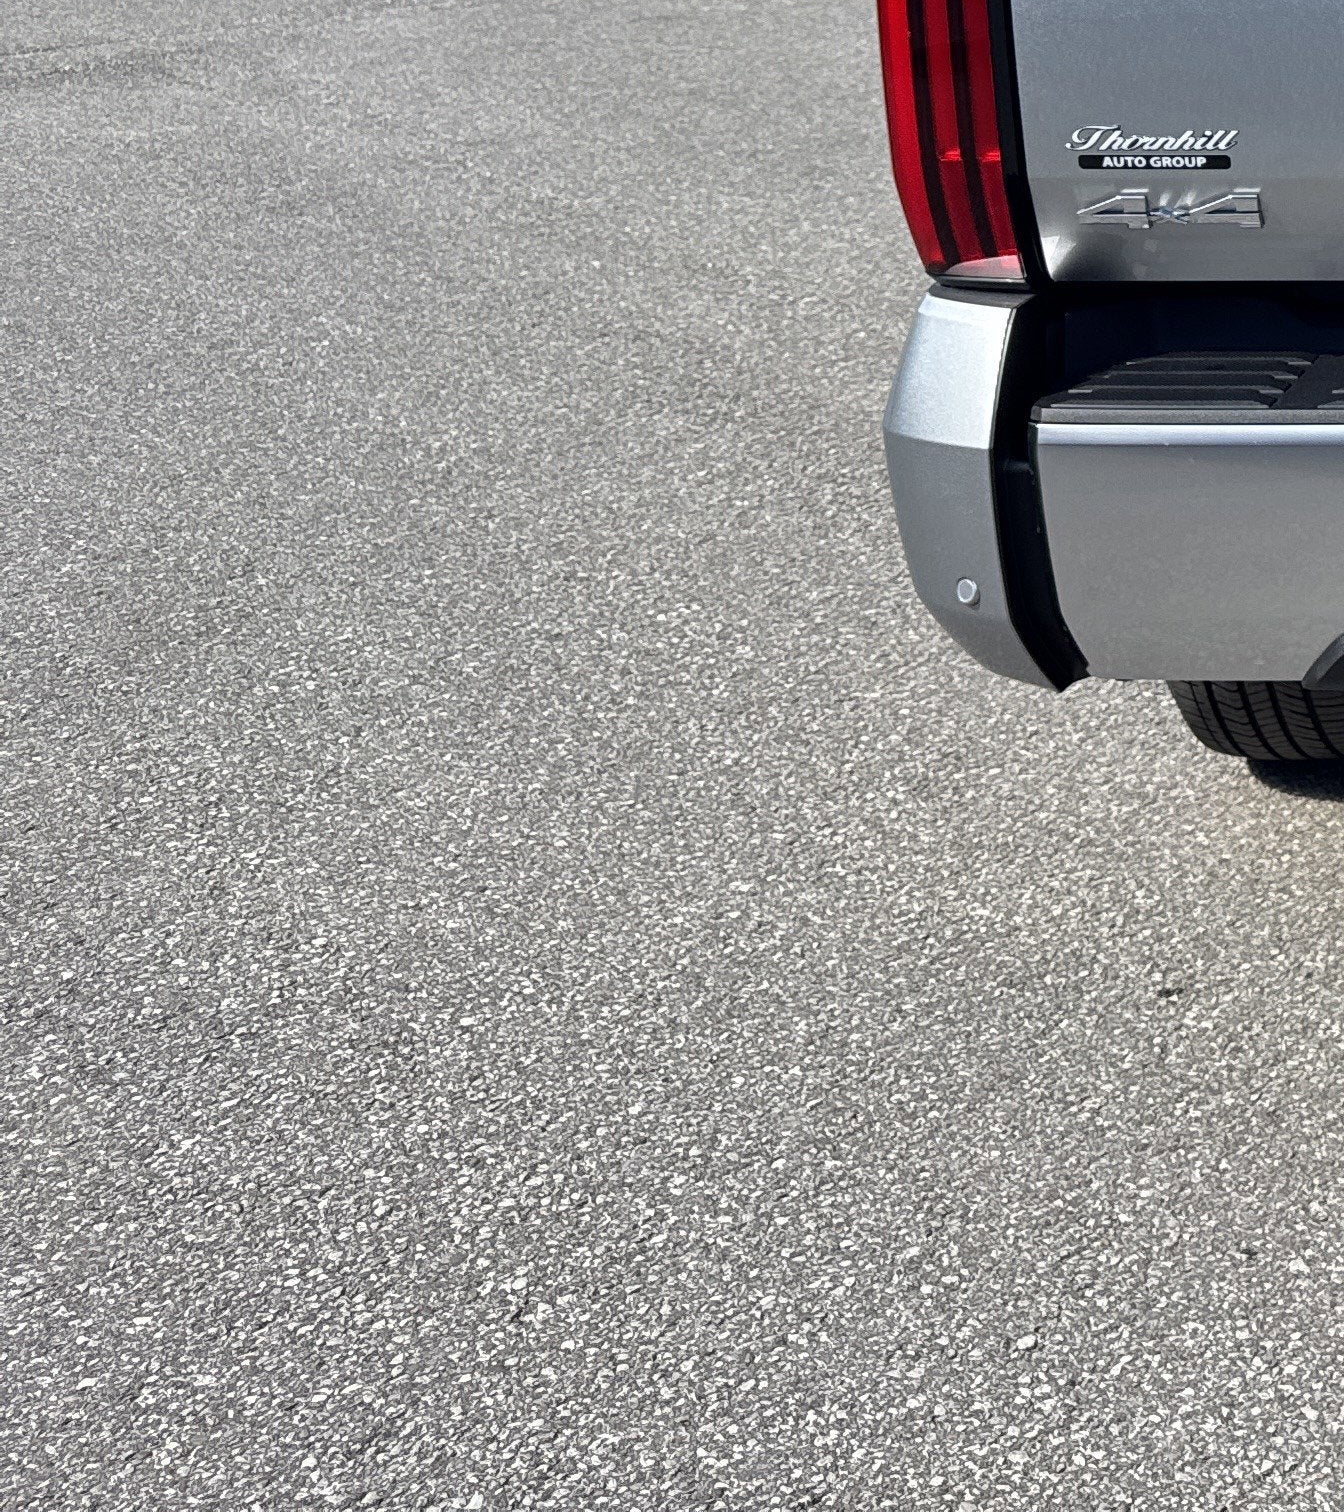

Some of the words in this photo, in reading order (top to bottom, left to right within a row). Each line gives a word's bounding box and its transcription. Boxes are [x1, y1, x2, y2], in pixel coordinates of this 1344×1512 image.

[1065, 124, 1240, 151] Thornhill
[1102, 156, 1147, 168] AUTO
[1149, 156, 1207, 168] GROUP
